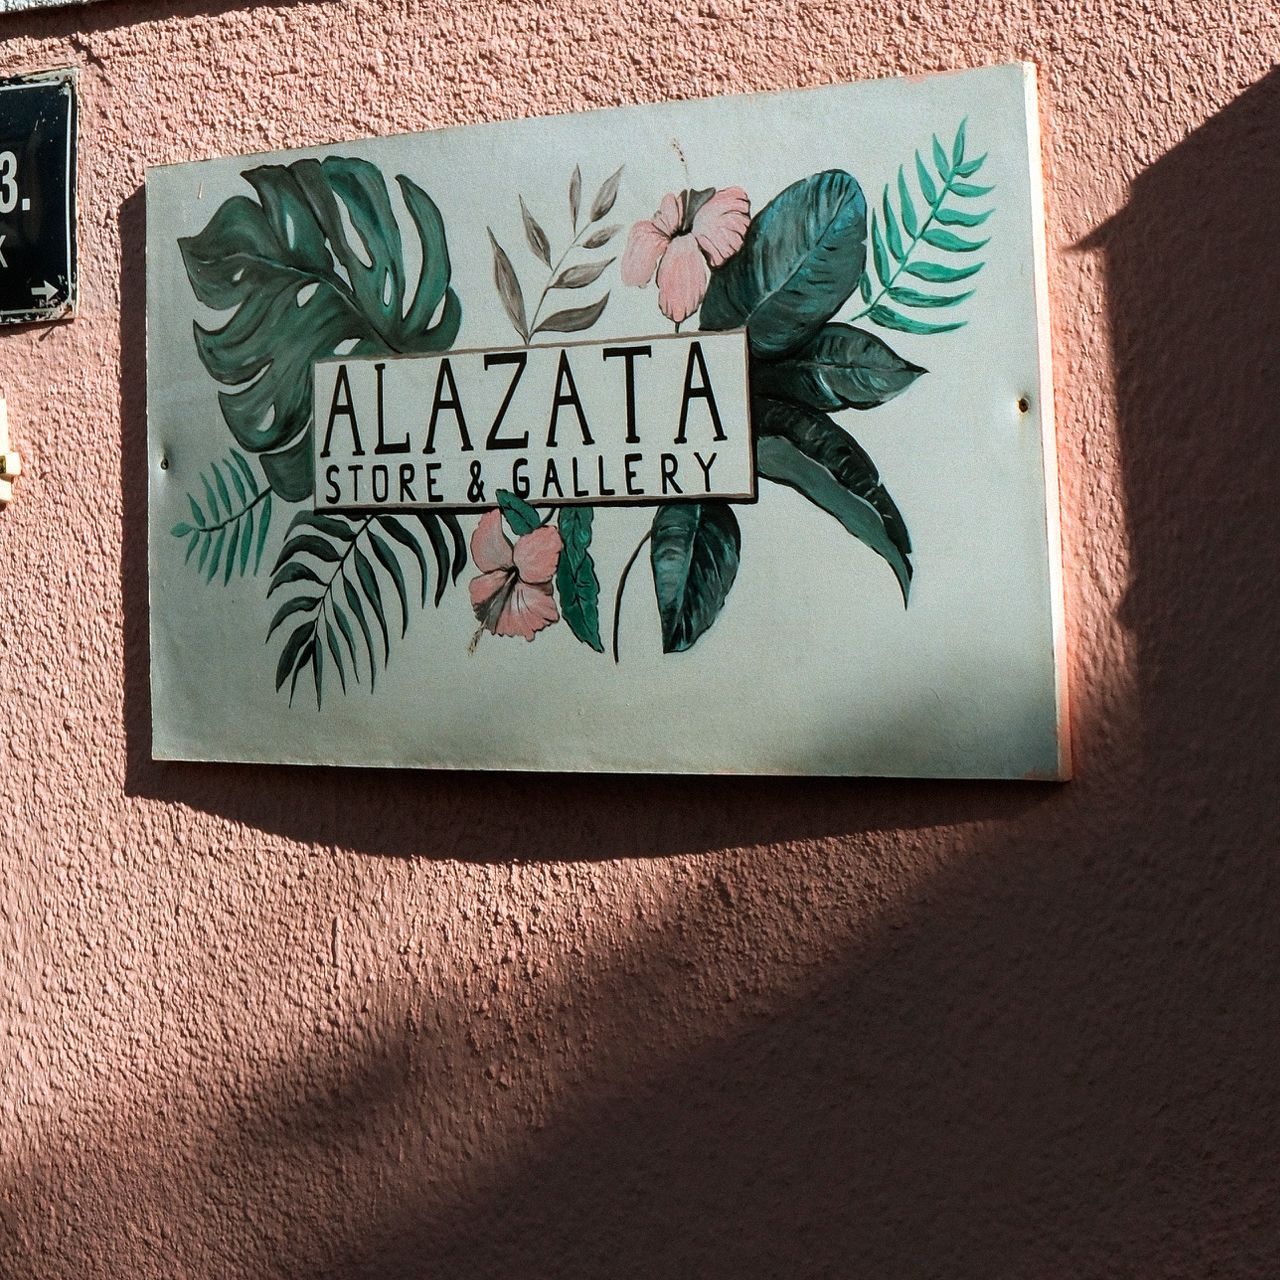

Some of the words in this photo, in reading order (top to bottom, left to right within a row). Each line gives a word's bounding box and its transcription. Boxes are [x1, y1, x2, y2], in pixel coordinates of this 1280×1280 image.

[320, 341, 728, 458] ALAZATA
[325, 461, 444, 504] STORE
[466, 459, 487, 503] &
[512, 451, 718, 500] GALLERY
